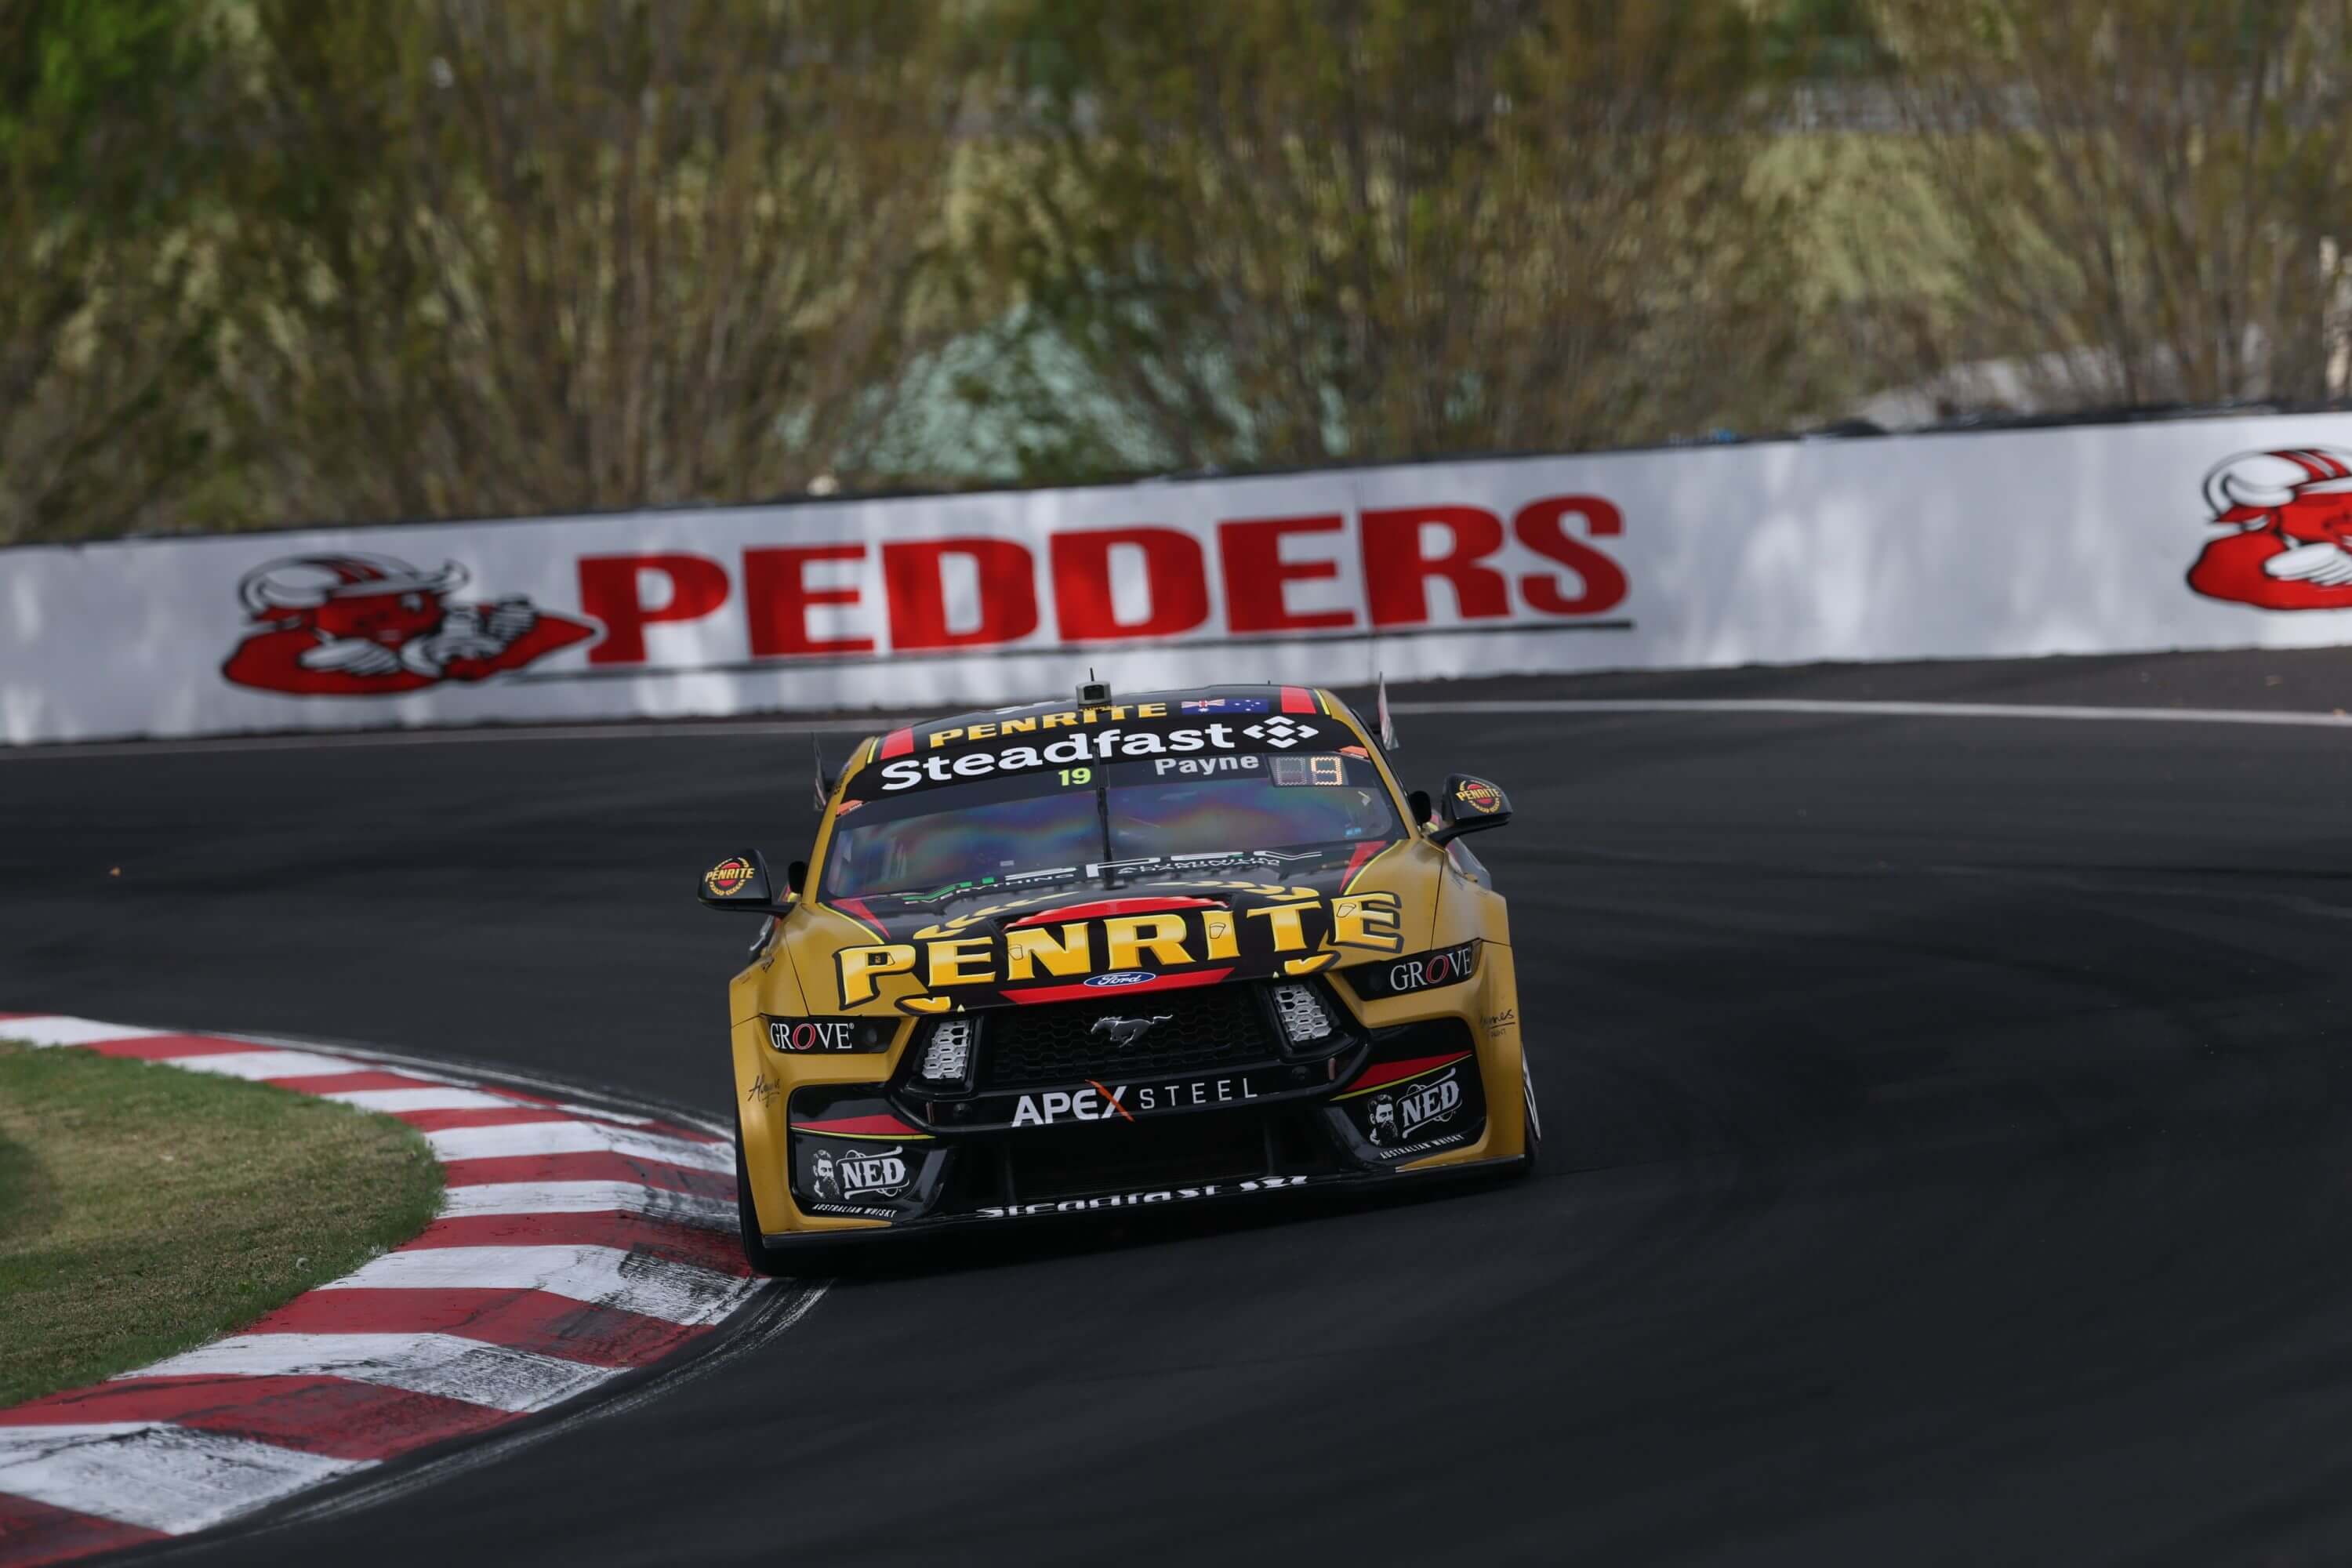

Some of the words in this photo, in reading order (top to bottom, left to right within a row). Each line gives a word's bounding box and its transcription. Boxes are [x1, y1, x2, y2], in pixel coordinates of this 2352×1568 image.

[578, 495, 1628, 665] PEDDERS
[928, 702, 1168, 749] PENRITE
[880, 724, 1236, 791] Steadfast
[1155, 755, 1260, 776] Payne
[1058, 767, 1091, 787] 19
[1455, 787, 1501, 801] PENRITE
[705, 867, 755, 883] PENRITE
[837, 894, 1401, 1009] PENRITE
[1390, 948, 1472, 991] GROVE
[1098, 972, 1142, 986] Ford
[1011, 1079, 1134, 1127] APEX
[1140, 1078, 1258, 1110] STEEL
[1401, 1080, 1460, 1128] NED
[841, 1158, 906, 1189] NED
[812, 1203, 863, 1214] AUSTRALIAN
[864, 1207, 898, 1218] WHISKY
